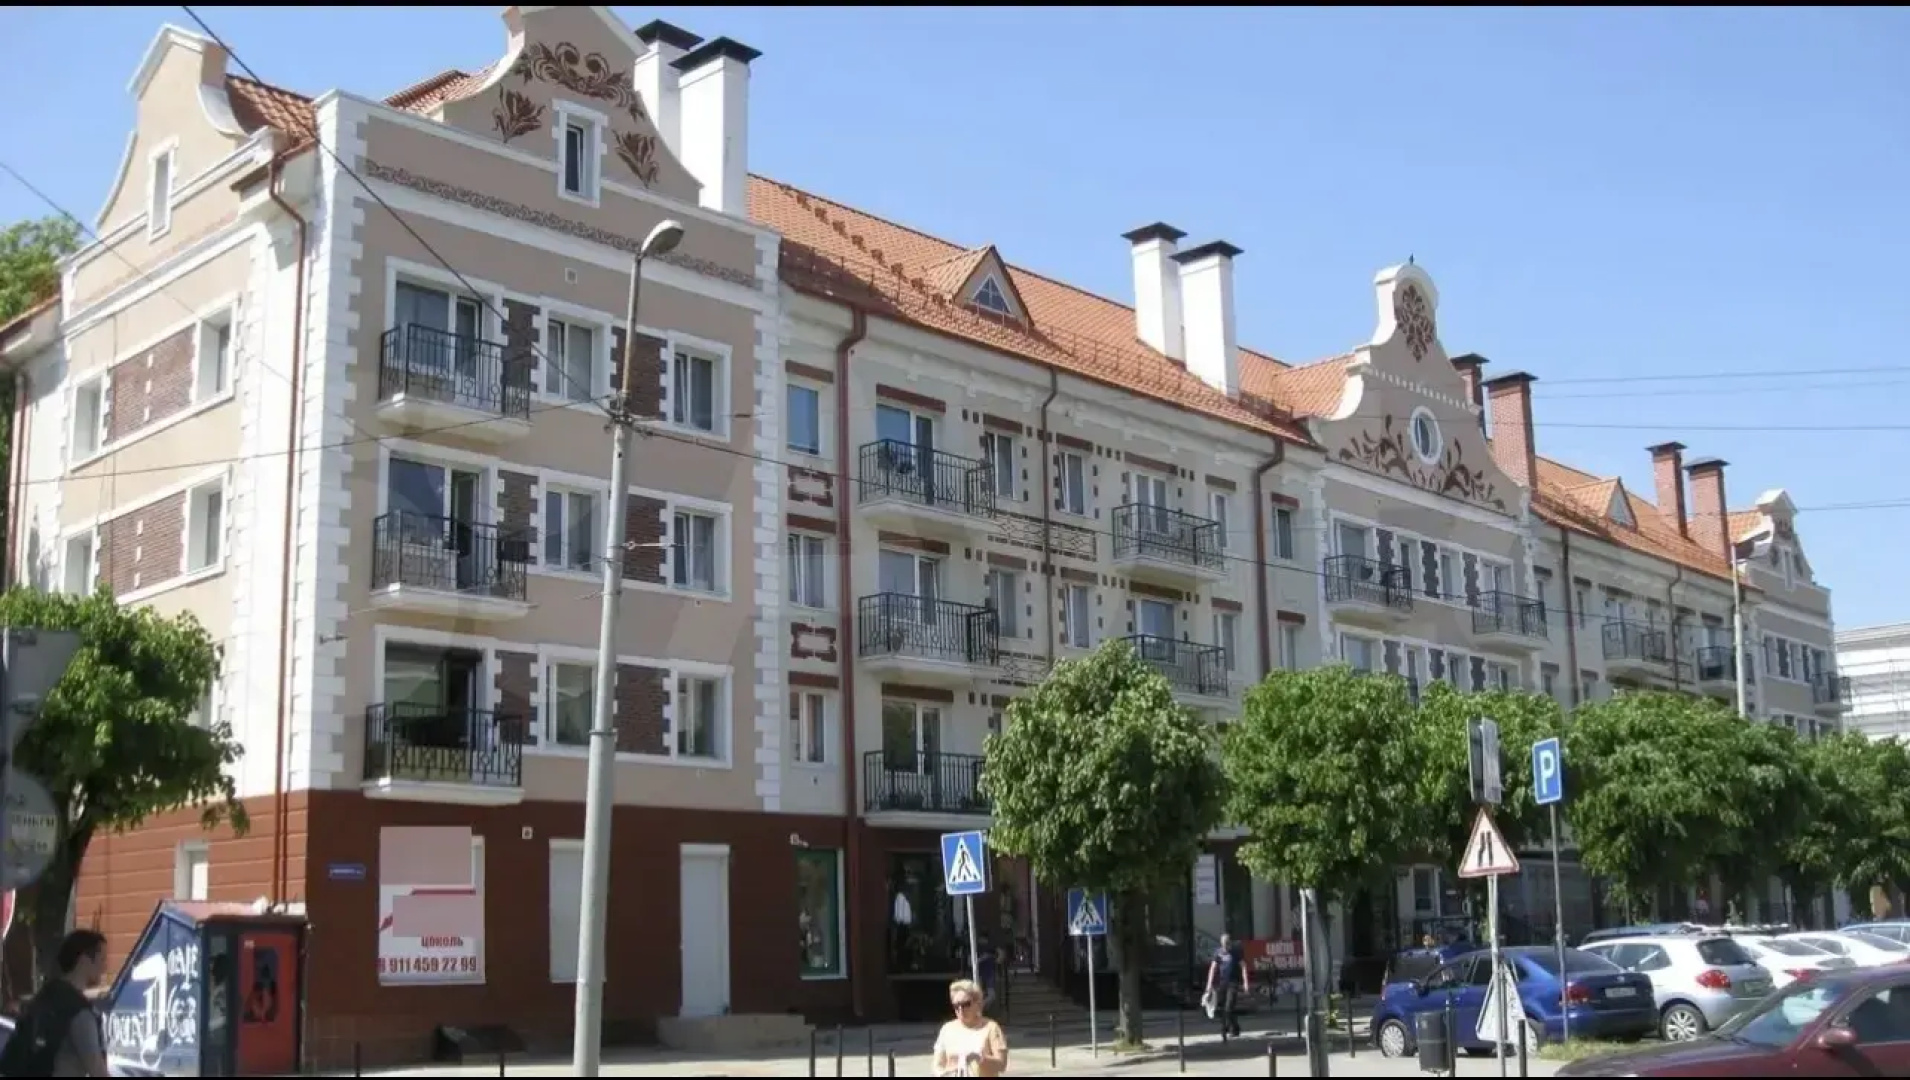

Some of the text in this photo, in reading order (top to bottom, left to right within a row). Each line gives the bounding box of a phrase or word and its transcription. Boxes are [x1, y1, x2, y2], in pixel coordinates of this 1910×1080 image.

[1540, 750, 1554, 794] P
[389, 957, 411, 973] 911
[442, 957, 458, 972] 22
